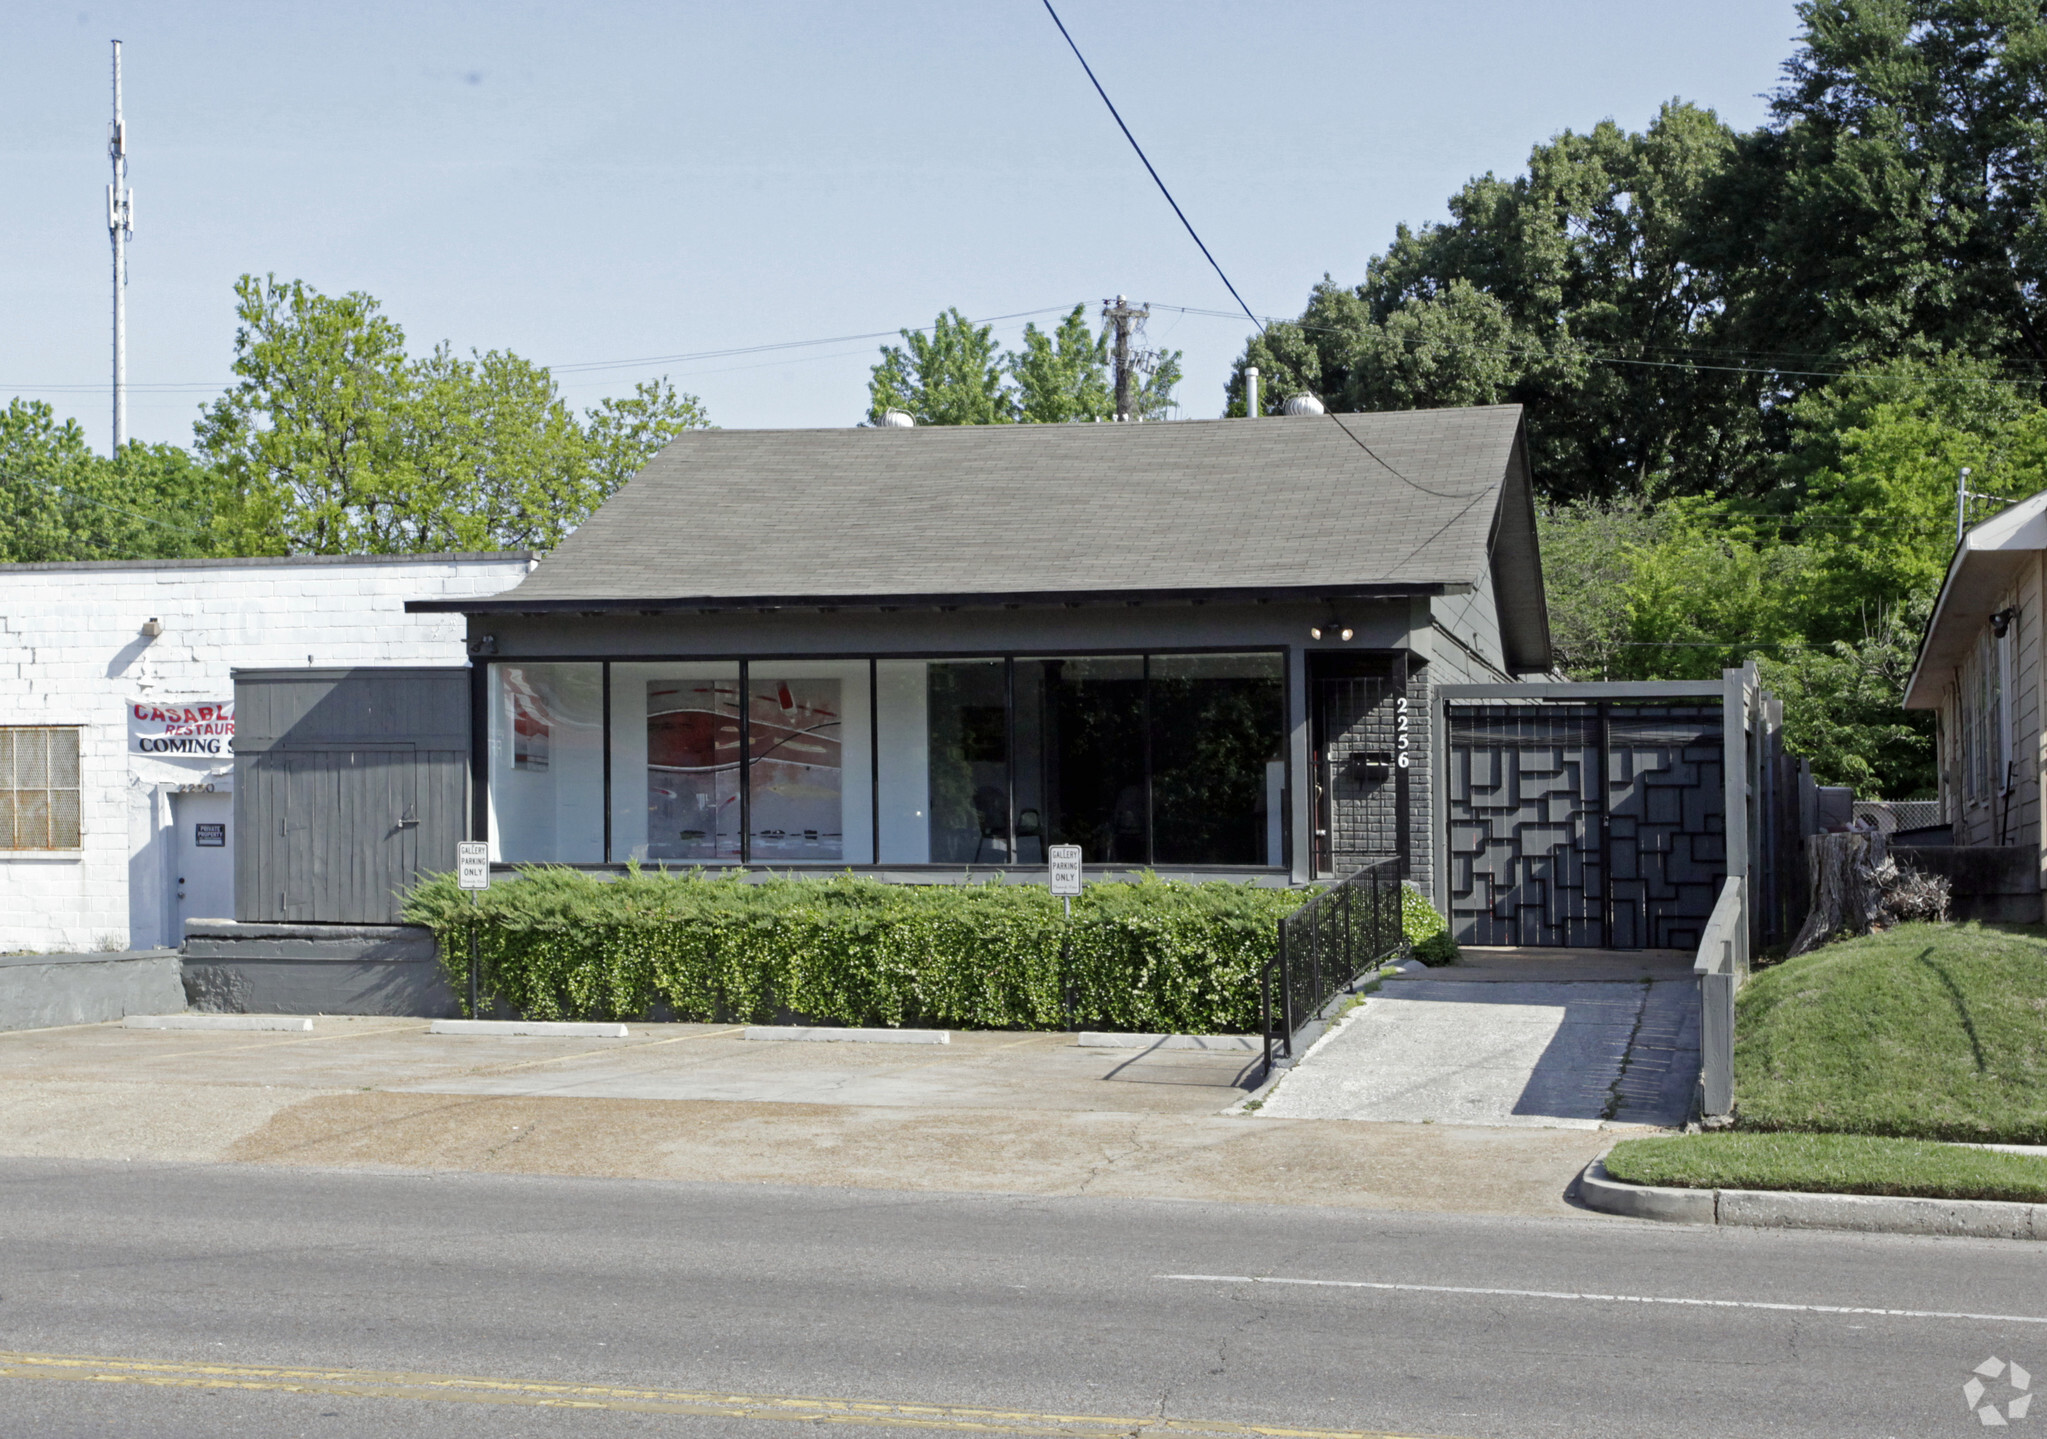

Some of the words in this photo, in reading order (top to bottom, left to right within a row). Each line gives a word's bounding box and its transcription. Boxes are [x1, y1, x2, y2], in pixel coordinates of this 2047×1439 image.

[134, 704, 235, 723] CASABL
[165, 723, 235, 736] RESTAUR
[1397, 697, 1409, 768] 2256
[139, 738, 221, 754] COMING
[461, 846, 486, 855] GALLERY
[1052, 850, 1078, 859] GALLERY
[461, 857, 486, 865] PARKING
[1052, 862, 1078, 870] PARKING
[463, 868, 483, 877] ONLY
[1055, 873, 1075, 882] ONLY
